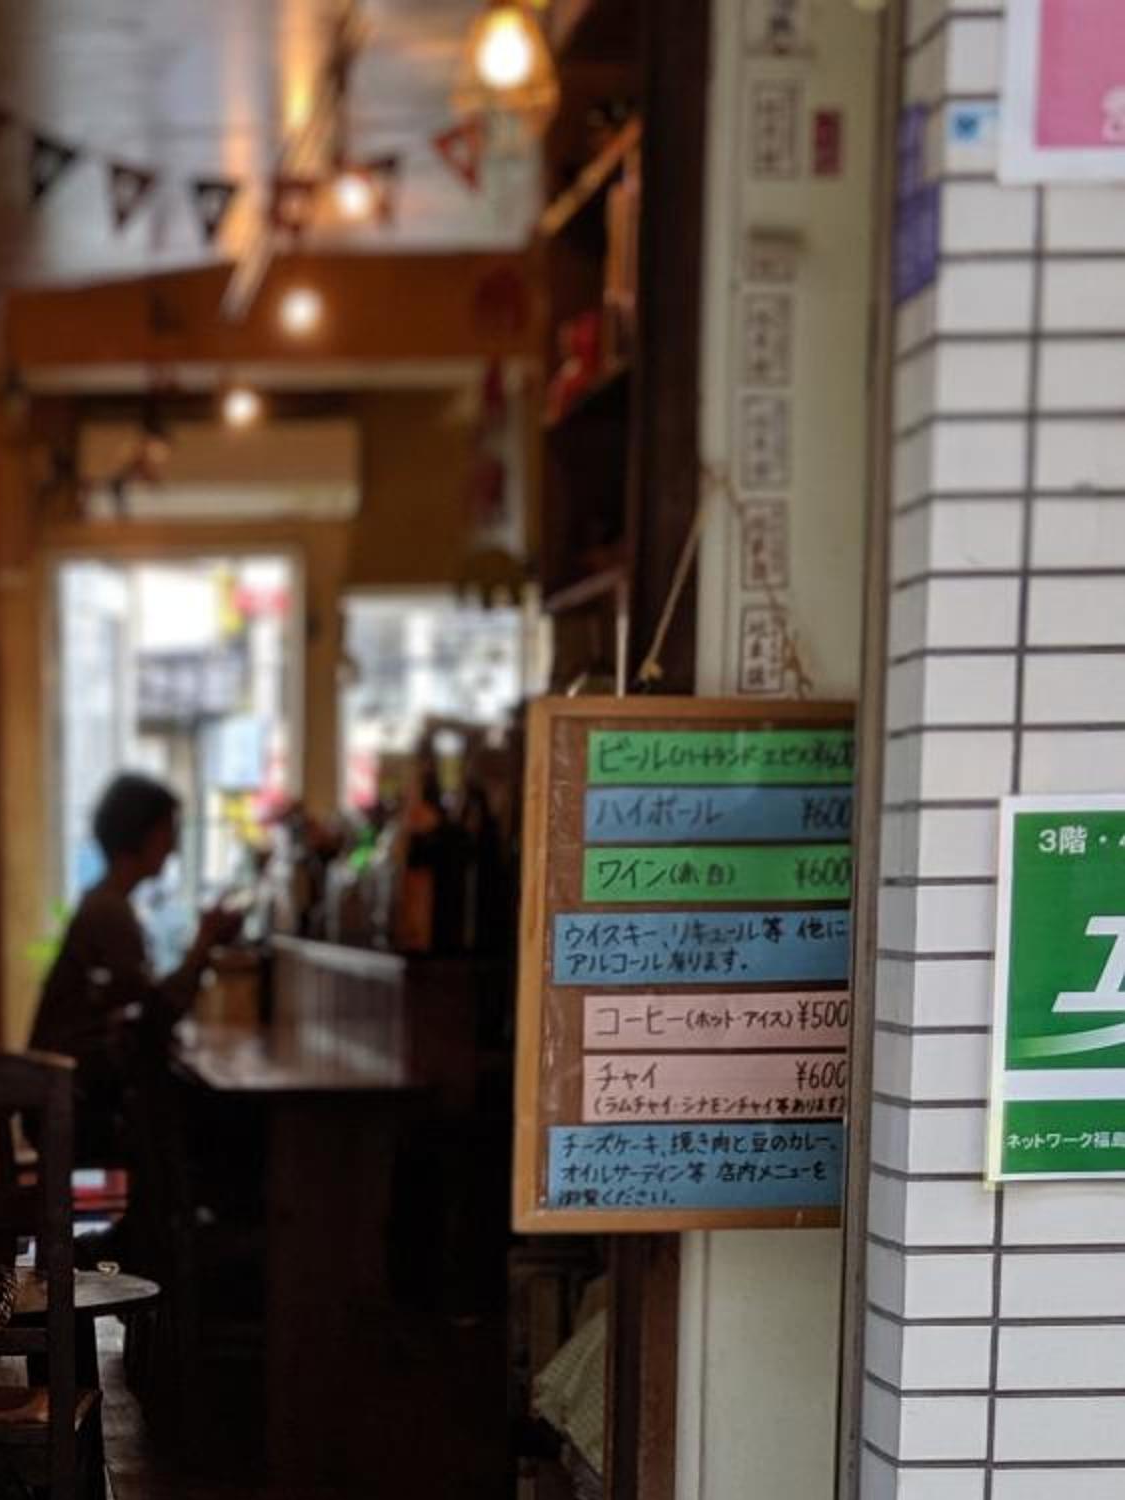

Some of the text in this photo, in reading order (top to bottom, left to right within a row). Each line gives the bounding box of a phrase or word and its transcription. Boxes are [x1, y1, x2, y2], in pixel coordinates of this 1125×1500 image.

[595, 794, 725, 828] ハイボール
[593, 1060, 660, 1093] チャイ
